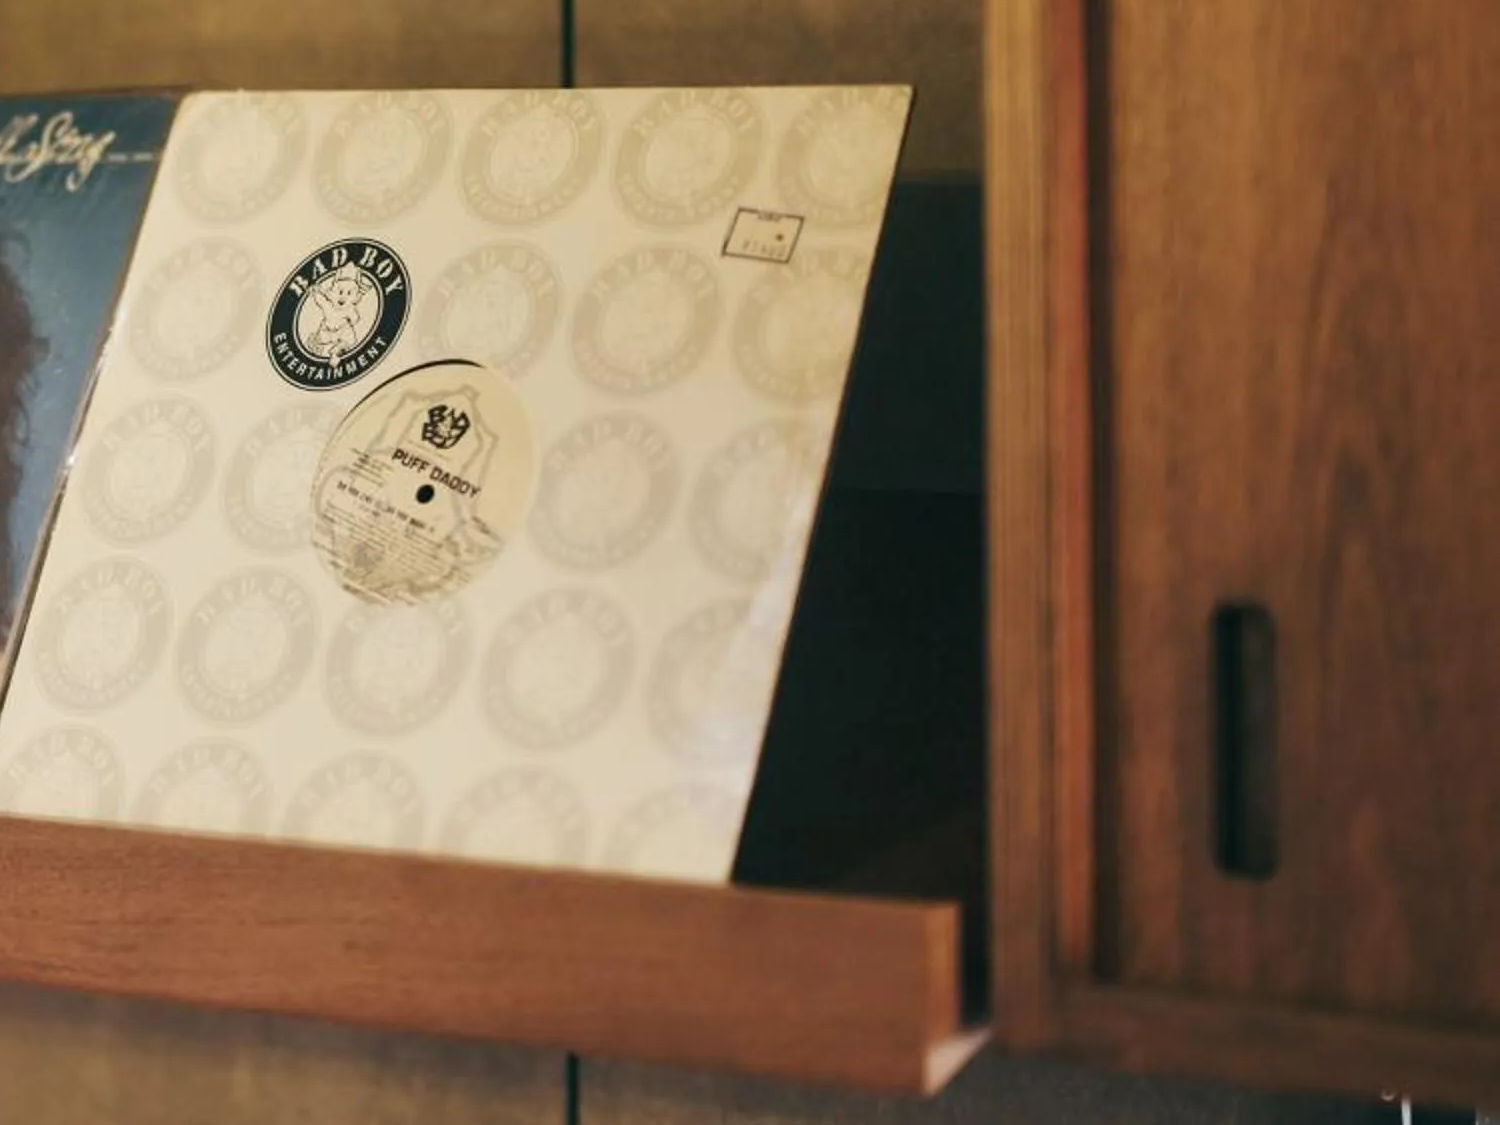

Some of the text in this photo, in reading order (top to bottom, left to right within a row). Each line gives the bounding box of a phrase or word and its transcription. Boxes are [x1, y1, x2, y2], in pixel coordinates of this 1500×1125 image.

[288, 245, 350, 297] BAD
[359, 246, 404, 297] BOY
[273, 331, 389, 381] ENTERTAINMENT
[392, 447, 430, 474] PUFF
[429, 466, 482, 499] DADDY
